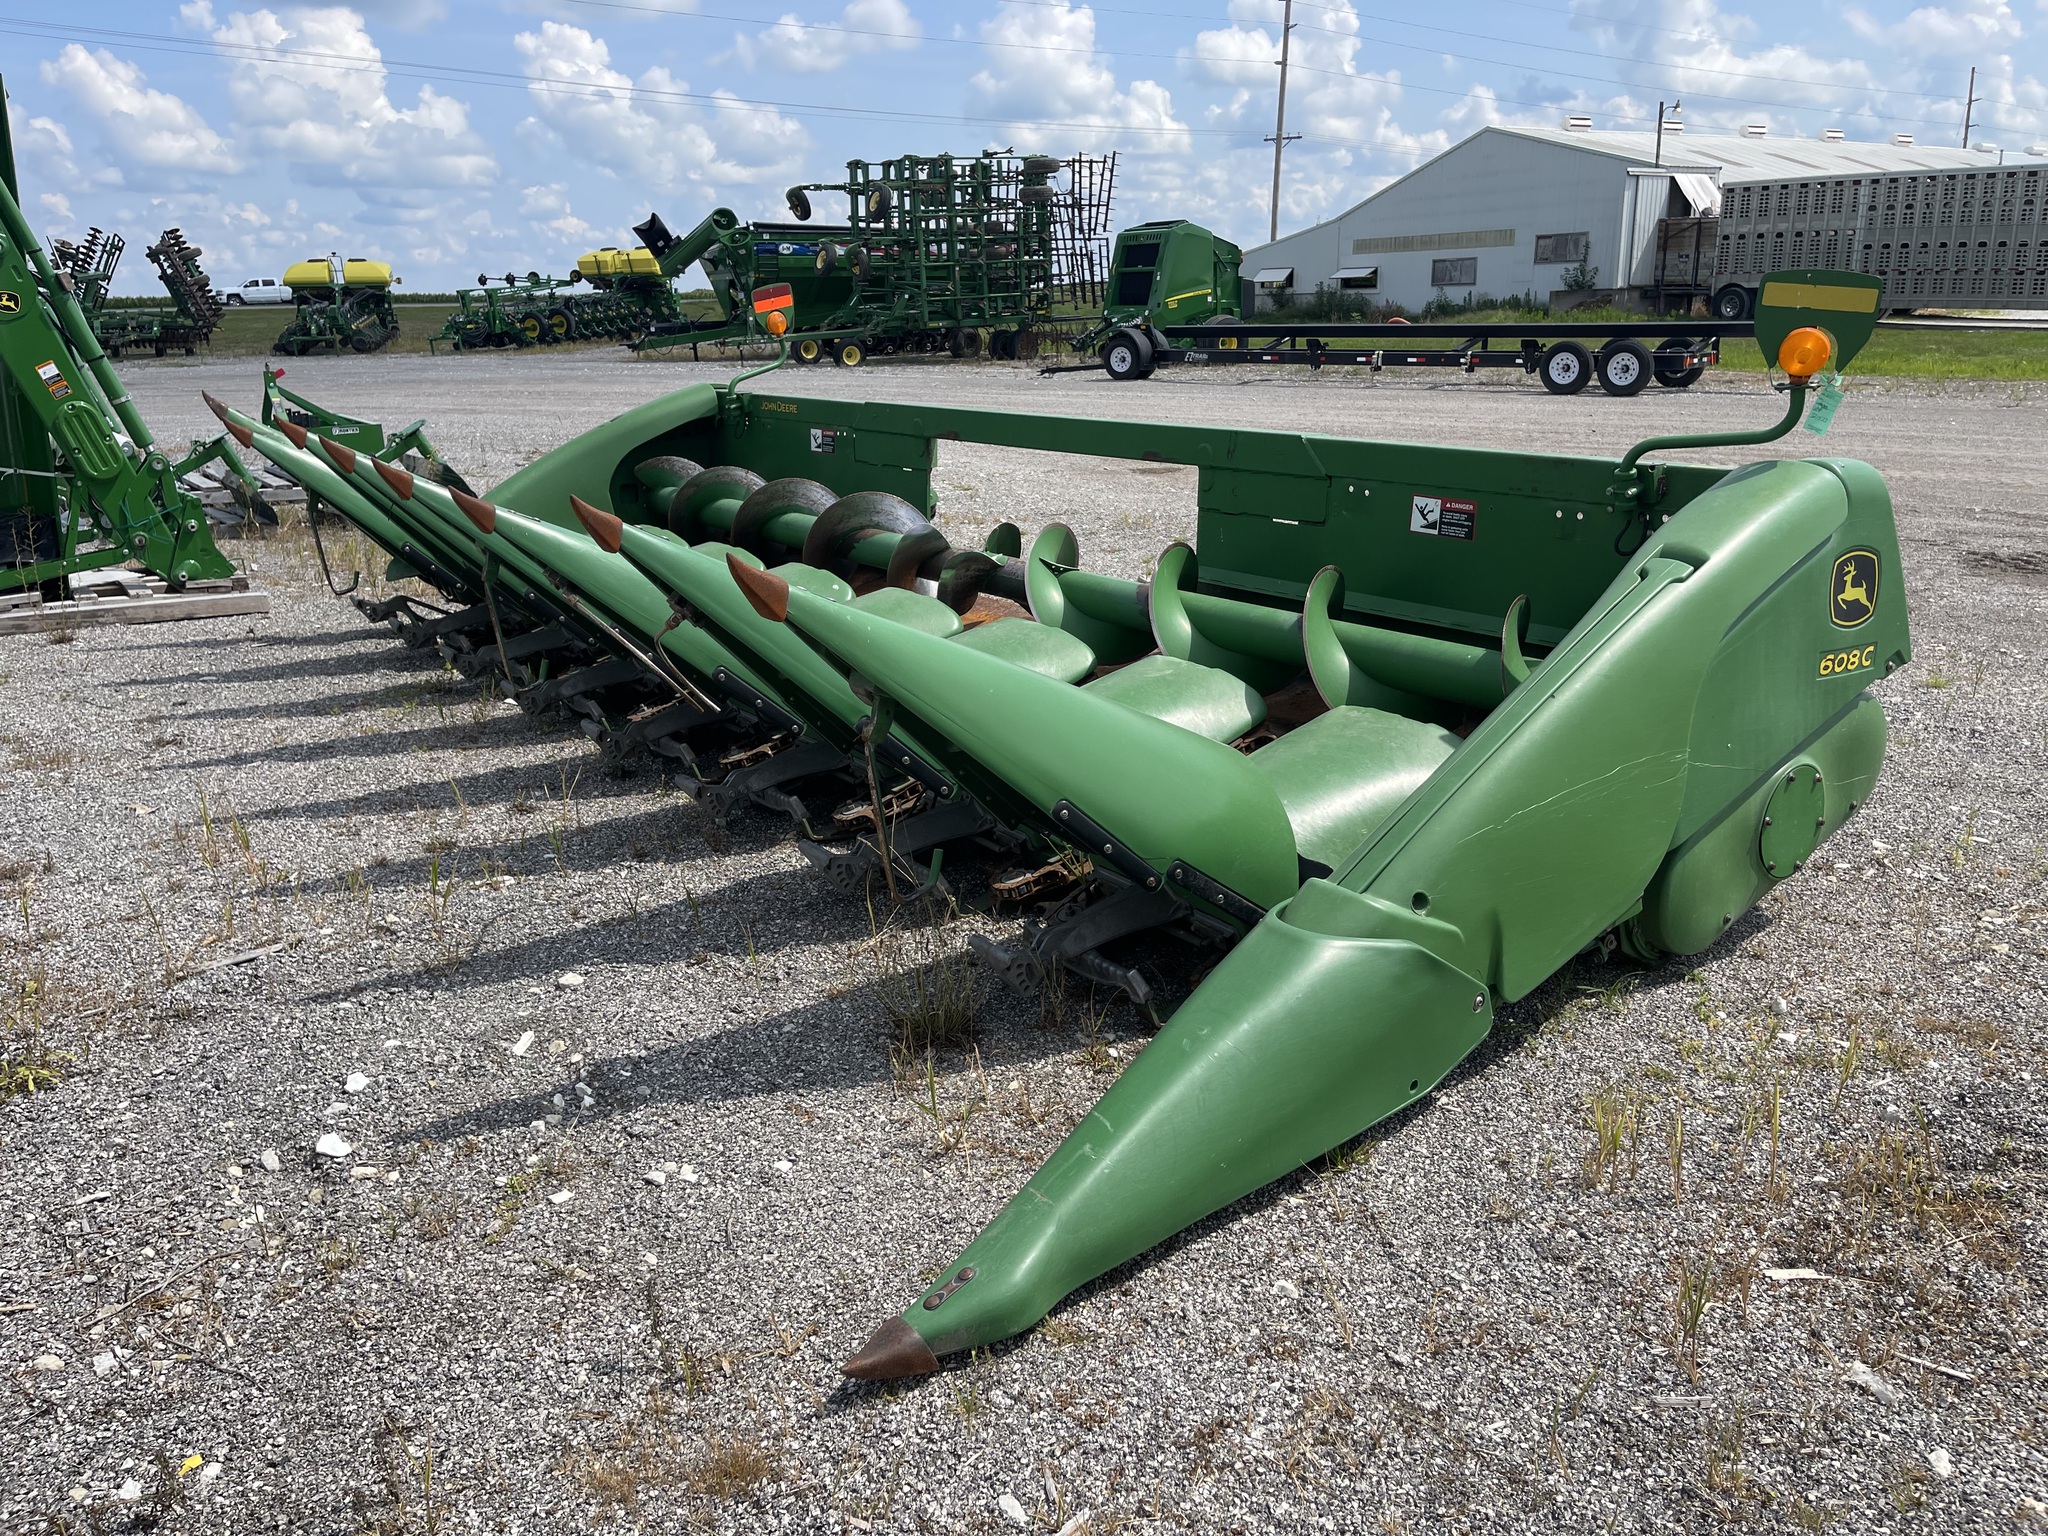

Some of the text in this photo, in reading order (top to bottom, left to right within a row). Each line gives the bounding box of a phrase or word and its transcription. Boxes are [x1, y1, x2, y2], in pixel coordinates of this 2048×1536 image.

[761, 401, 798, 413] JOHN DEERE
[1451, 502, 1474, 511] DANGER
[1819, 645, 1875, 676] 608C
